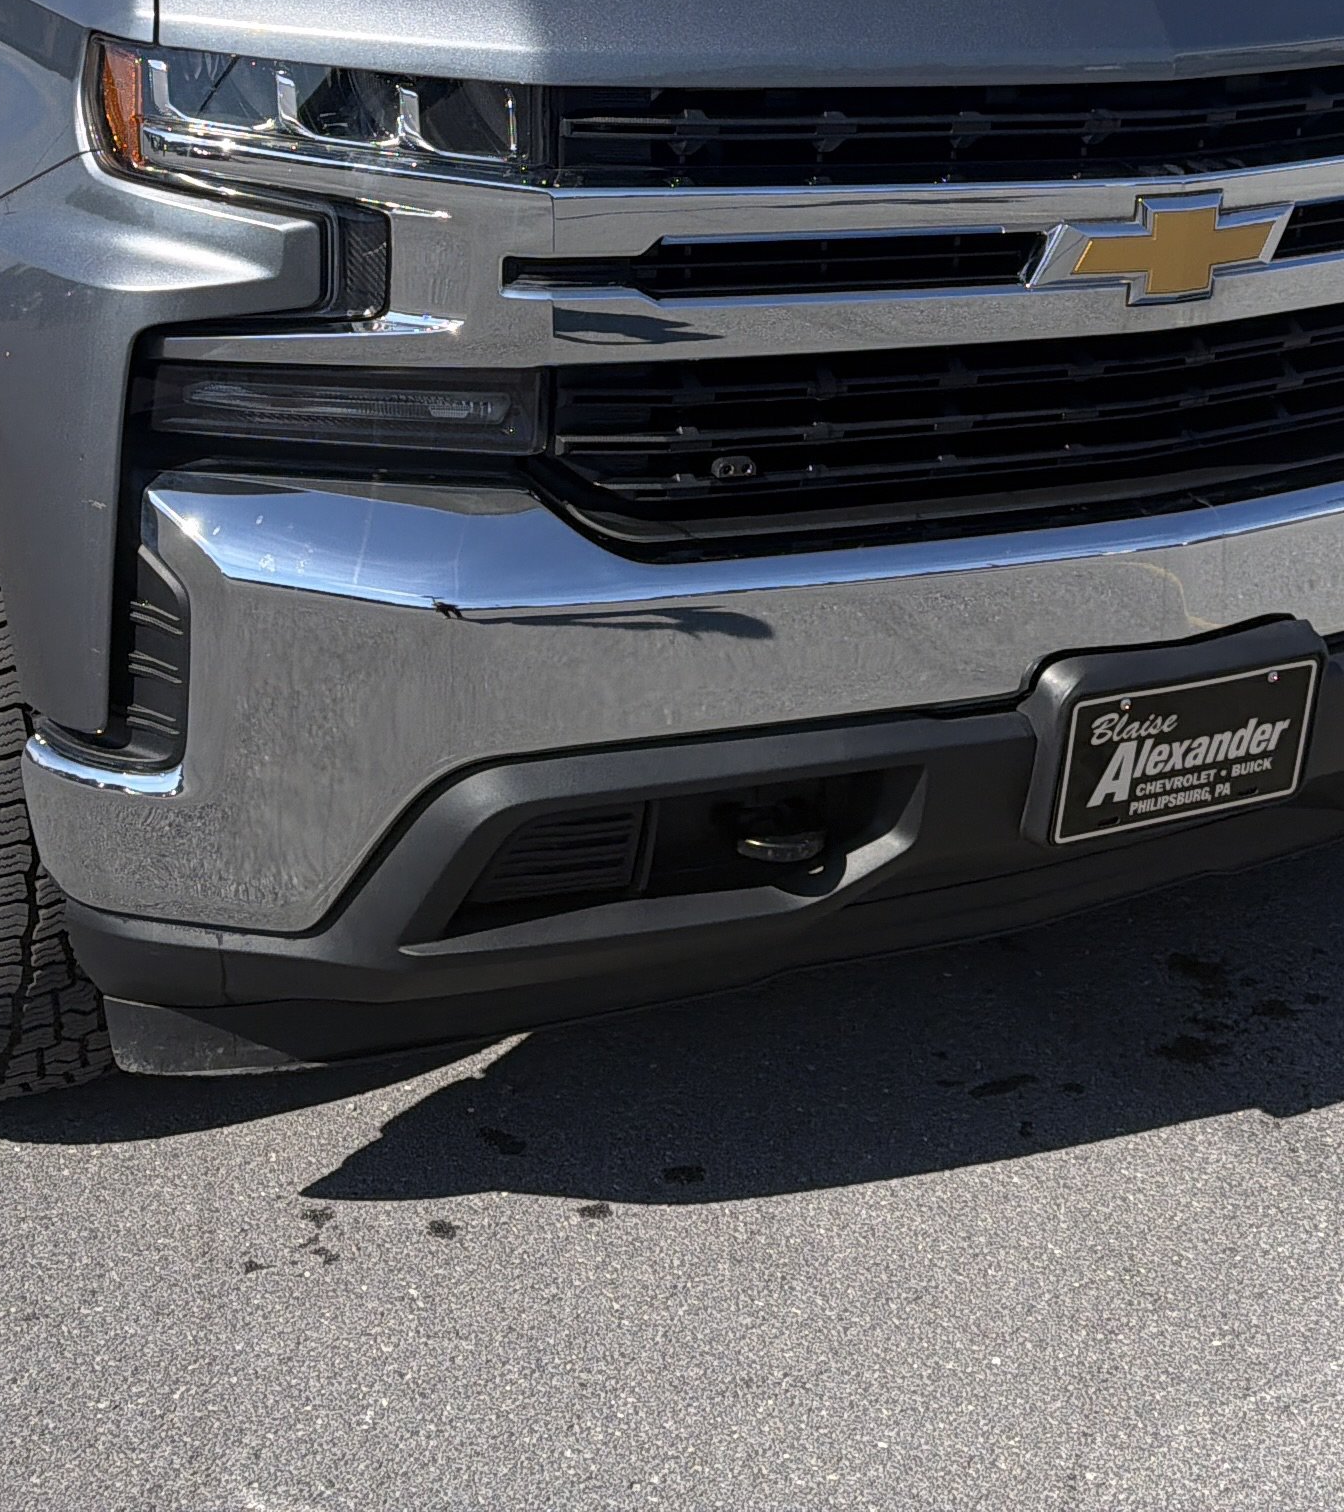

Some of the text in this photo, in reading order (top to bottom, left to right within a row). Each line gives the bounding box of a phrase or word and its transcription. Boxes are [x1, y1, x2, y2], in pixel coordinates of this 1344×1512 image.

[1090, 712, 1179, 746] Blaise
[1085, 717, 1291, 809] Alexander
[1135, 756, 1273, 797] CHEVROLET BUICK
[1128, 782, 1231, 816] PHILIPSBURG, PA
